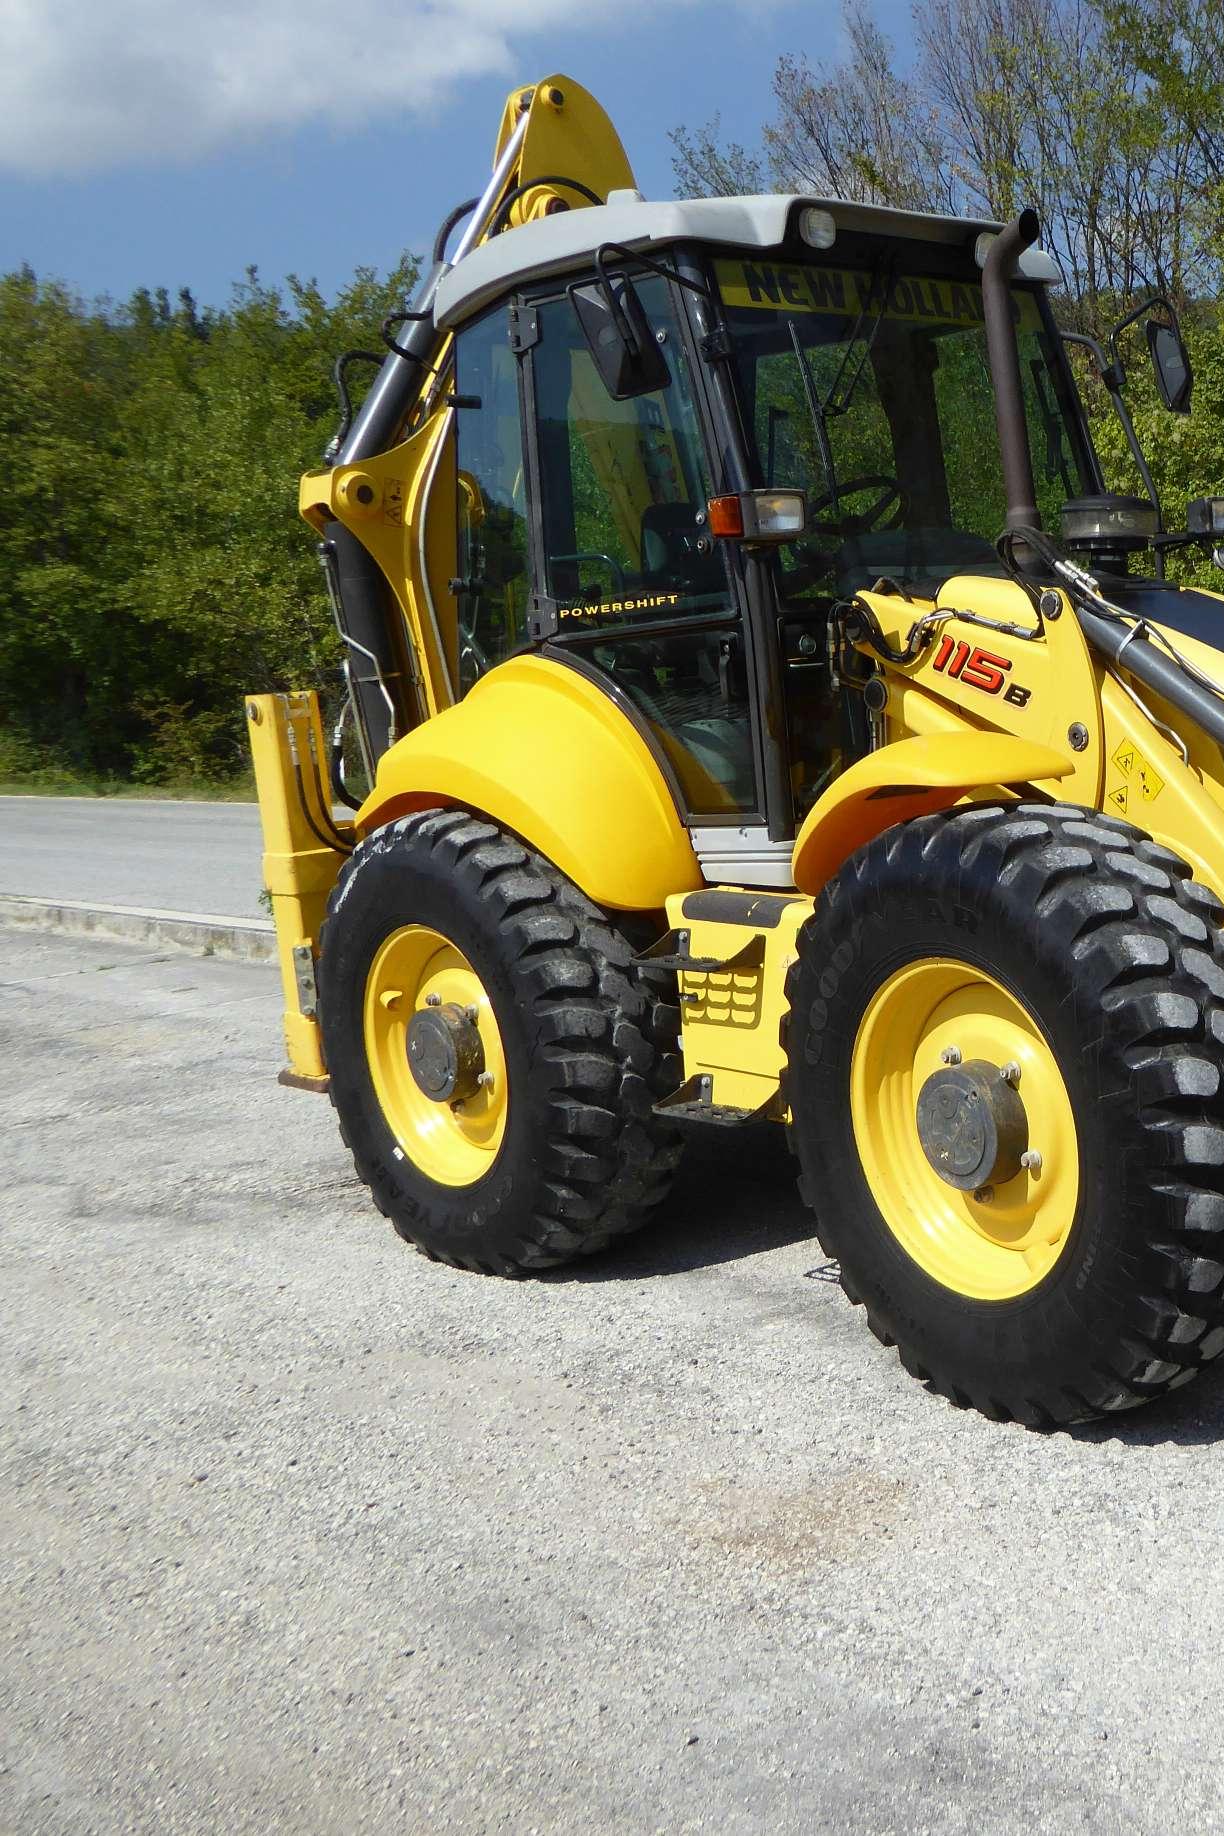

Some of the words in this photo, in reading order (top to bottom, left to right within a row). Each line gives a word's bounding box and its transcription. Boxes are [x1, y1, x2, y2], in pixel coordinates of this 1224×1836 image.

[741, 262, 847, 310] NEW
[854, 271, 1022, 324] HOLLA
[560, 594, 679, 618] POWERSHIFT
[932, 634, 1012, 695] 115
